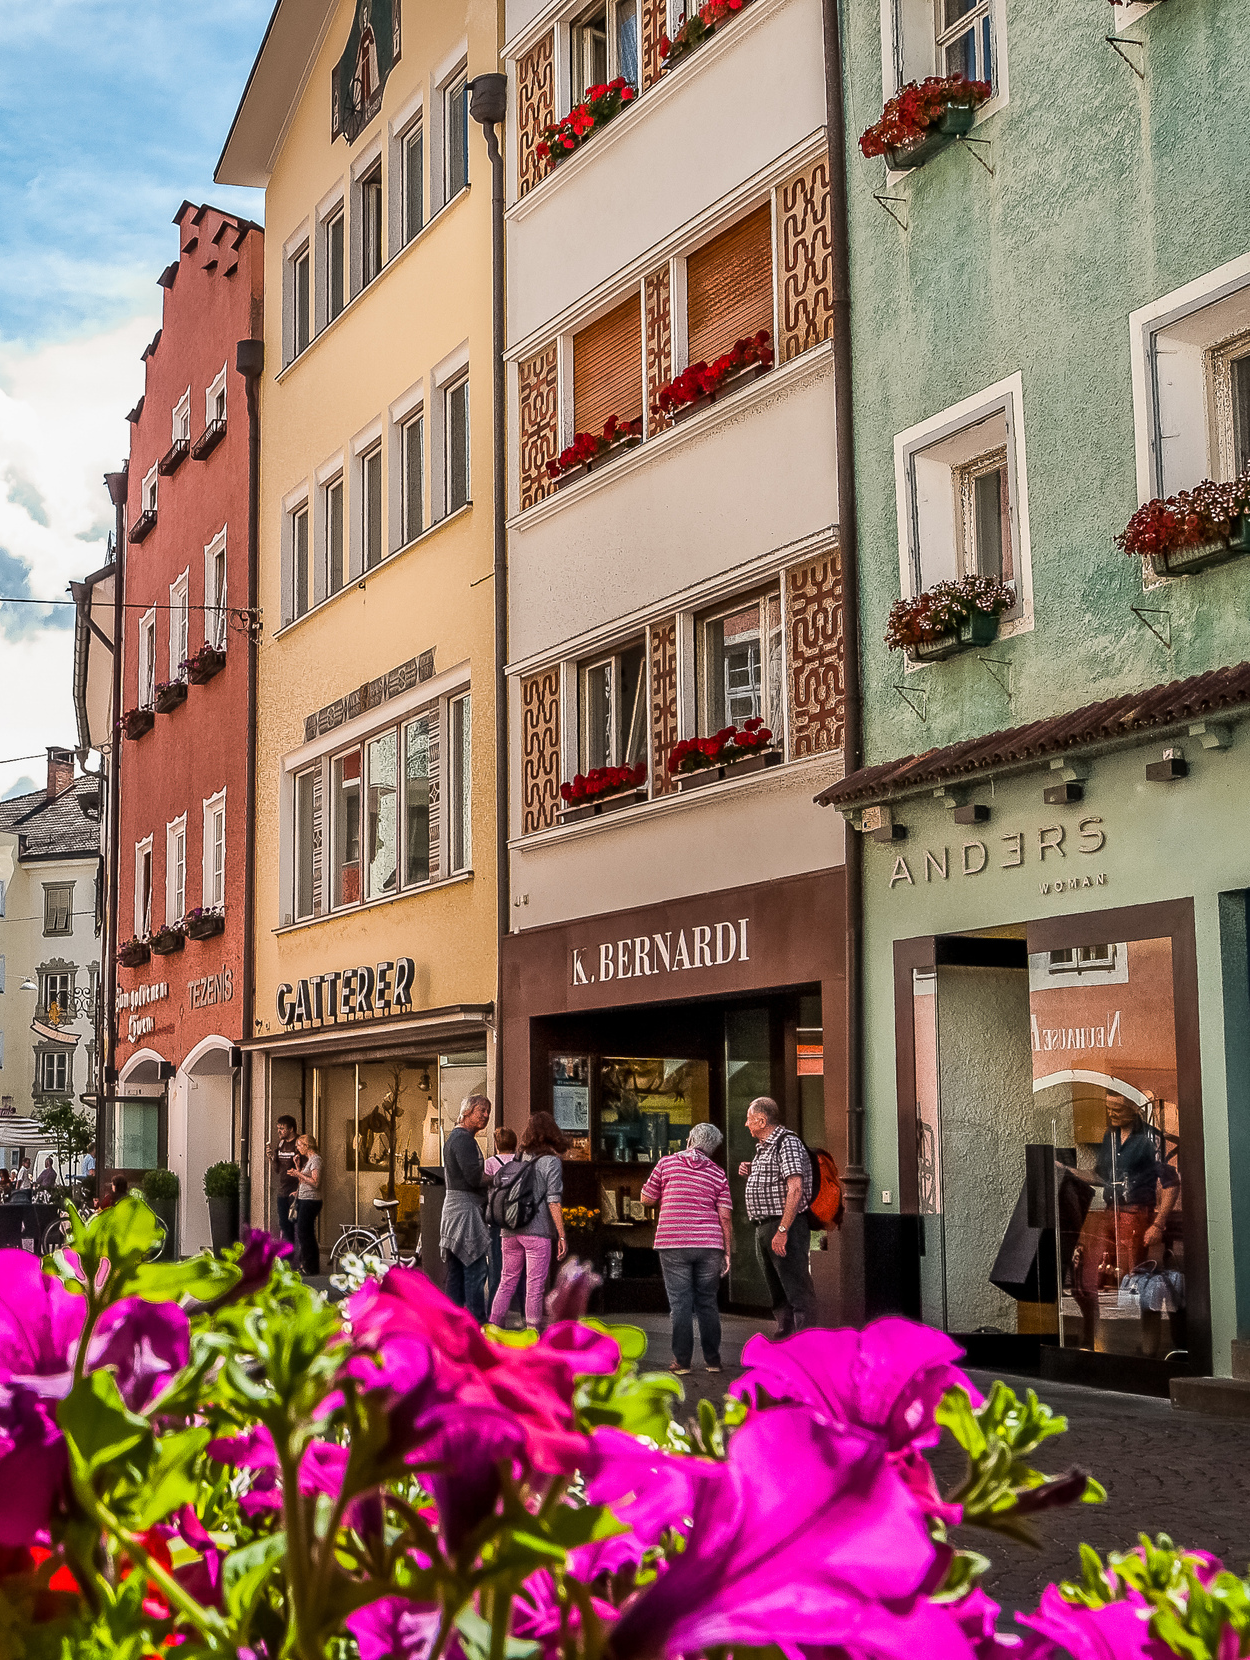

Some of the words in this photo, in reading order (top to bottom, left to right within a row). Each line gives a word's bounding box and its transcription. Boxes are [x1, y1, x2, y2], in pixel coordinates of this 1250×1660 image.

[1038, 873, 1108, 895] WOMAN
[570, 947, 595, 986] K.
[598, 918, 750, 982] BERNARDI
[187, 964, 233, 1010] TEZENIS
[275, 957, 415, 1027] GATTERER
